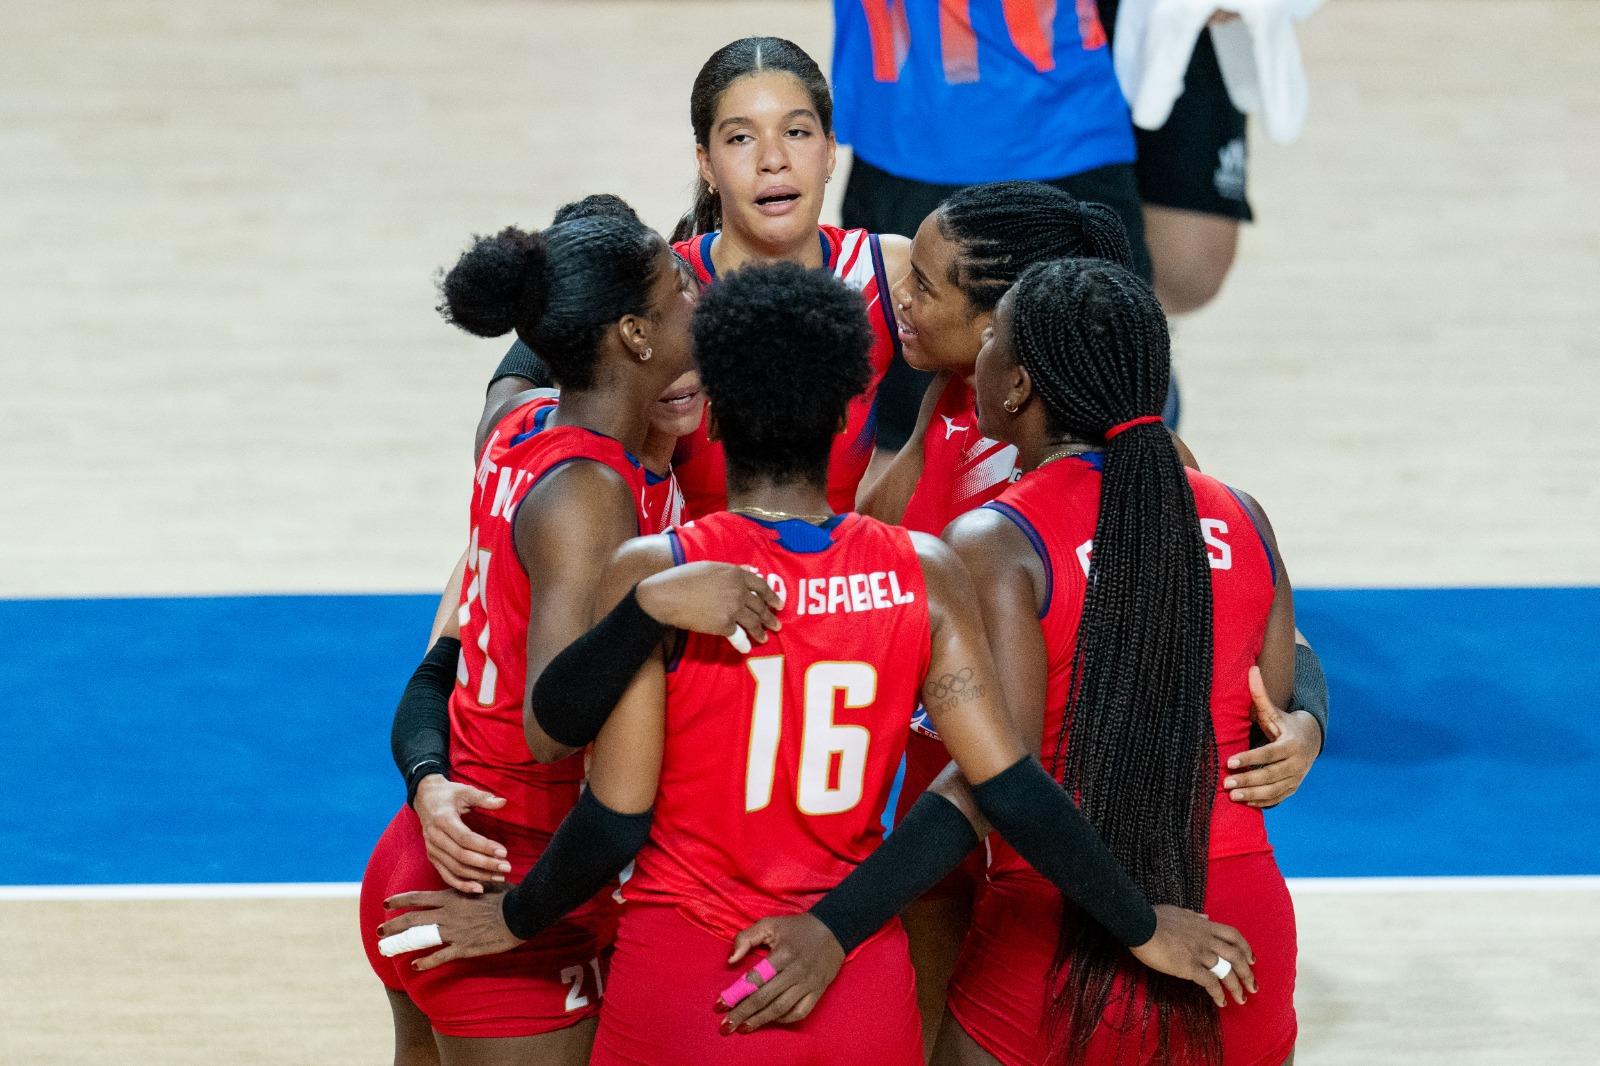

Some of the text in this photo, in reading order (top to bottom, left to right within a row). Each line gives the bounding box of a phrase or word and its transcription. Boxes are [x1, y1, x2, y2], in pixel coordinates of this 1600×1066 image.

[797, 571, 914, 615] ISABEL
[745, 654, 878, 816] 16
[561, 958, 603, 1012] 21
